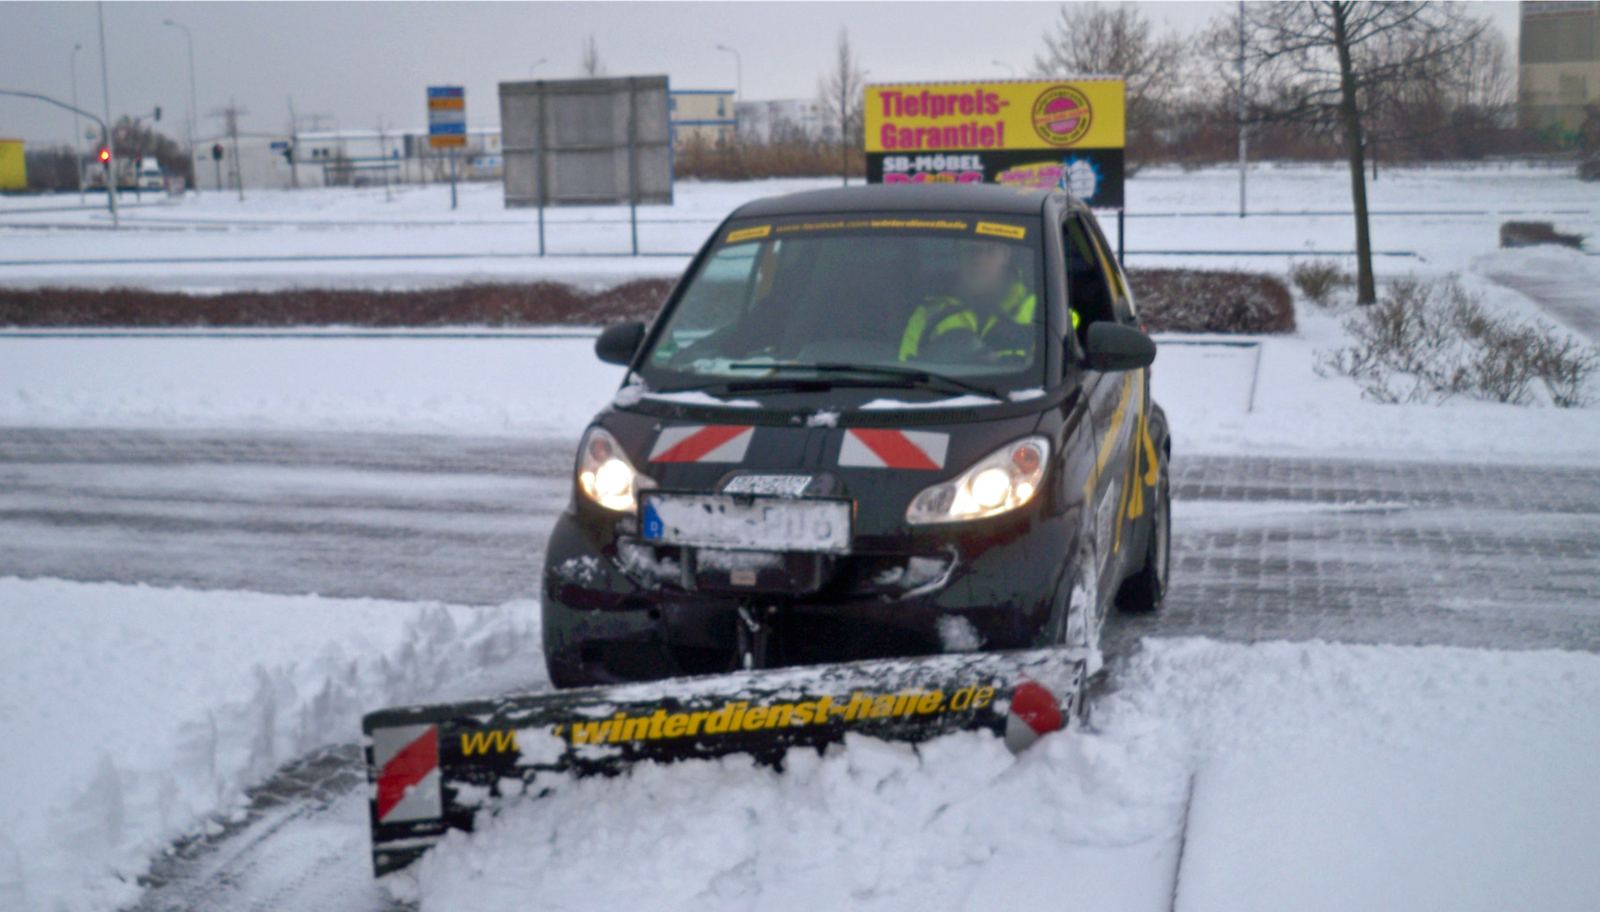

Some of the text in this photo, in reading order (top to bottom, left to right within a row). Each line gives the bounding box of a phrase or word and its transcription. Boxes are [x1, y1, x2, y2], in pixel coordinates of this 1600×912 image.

[879, 89, 1010, 118] Tiefpreis-
[880, 120, 1005, 150] Garantie!
[883, 153, 984, 172] SB-MÖBEL
